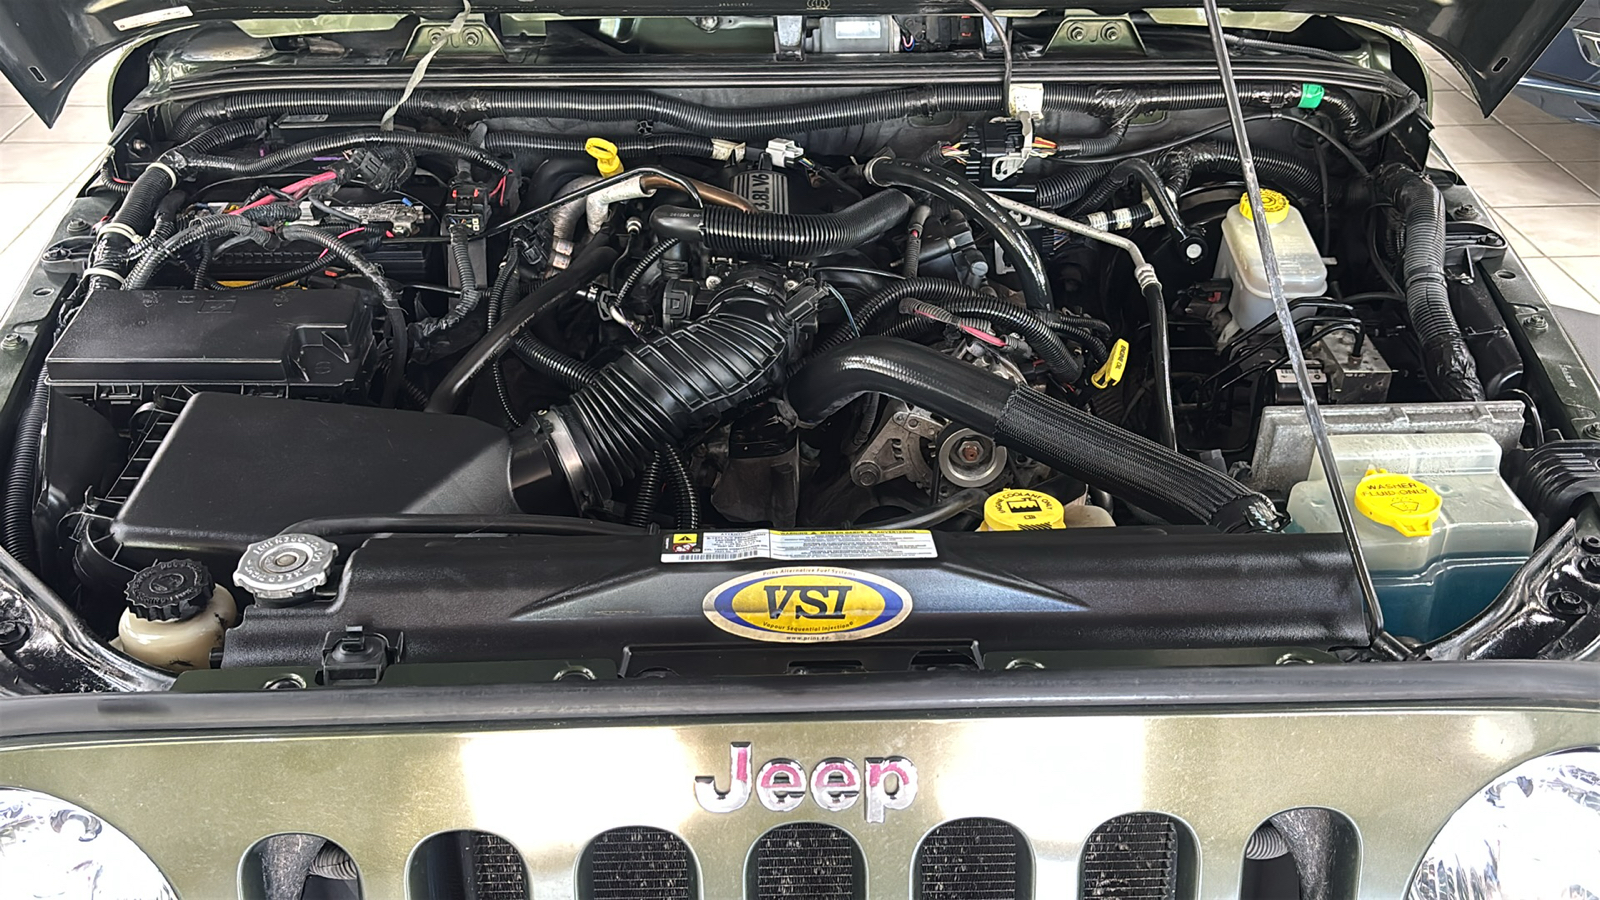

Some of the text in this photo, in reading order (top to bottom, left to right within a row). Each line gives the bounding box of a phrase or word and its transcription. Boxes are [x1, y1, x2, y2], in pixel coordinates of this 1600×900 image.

[752, 173, 770, 187] V6
[1366, 482, 1418, 490] WASHER
[1398, 488, 1429, 496] ONLY
[1002, 491, 1042, 499] COOLANT
[1041, 498, 1053, 510] ONLY
[831, 568, 857, 577] Systems
[763, 585, 853, 620] VSI
[763, 621, 786, 630] Vapour
[694, 741, 918, 824] Jeep
